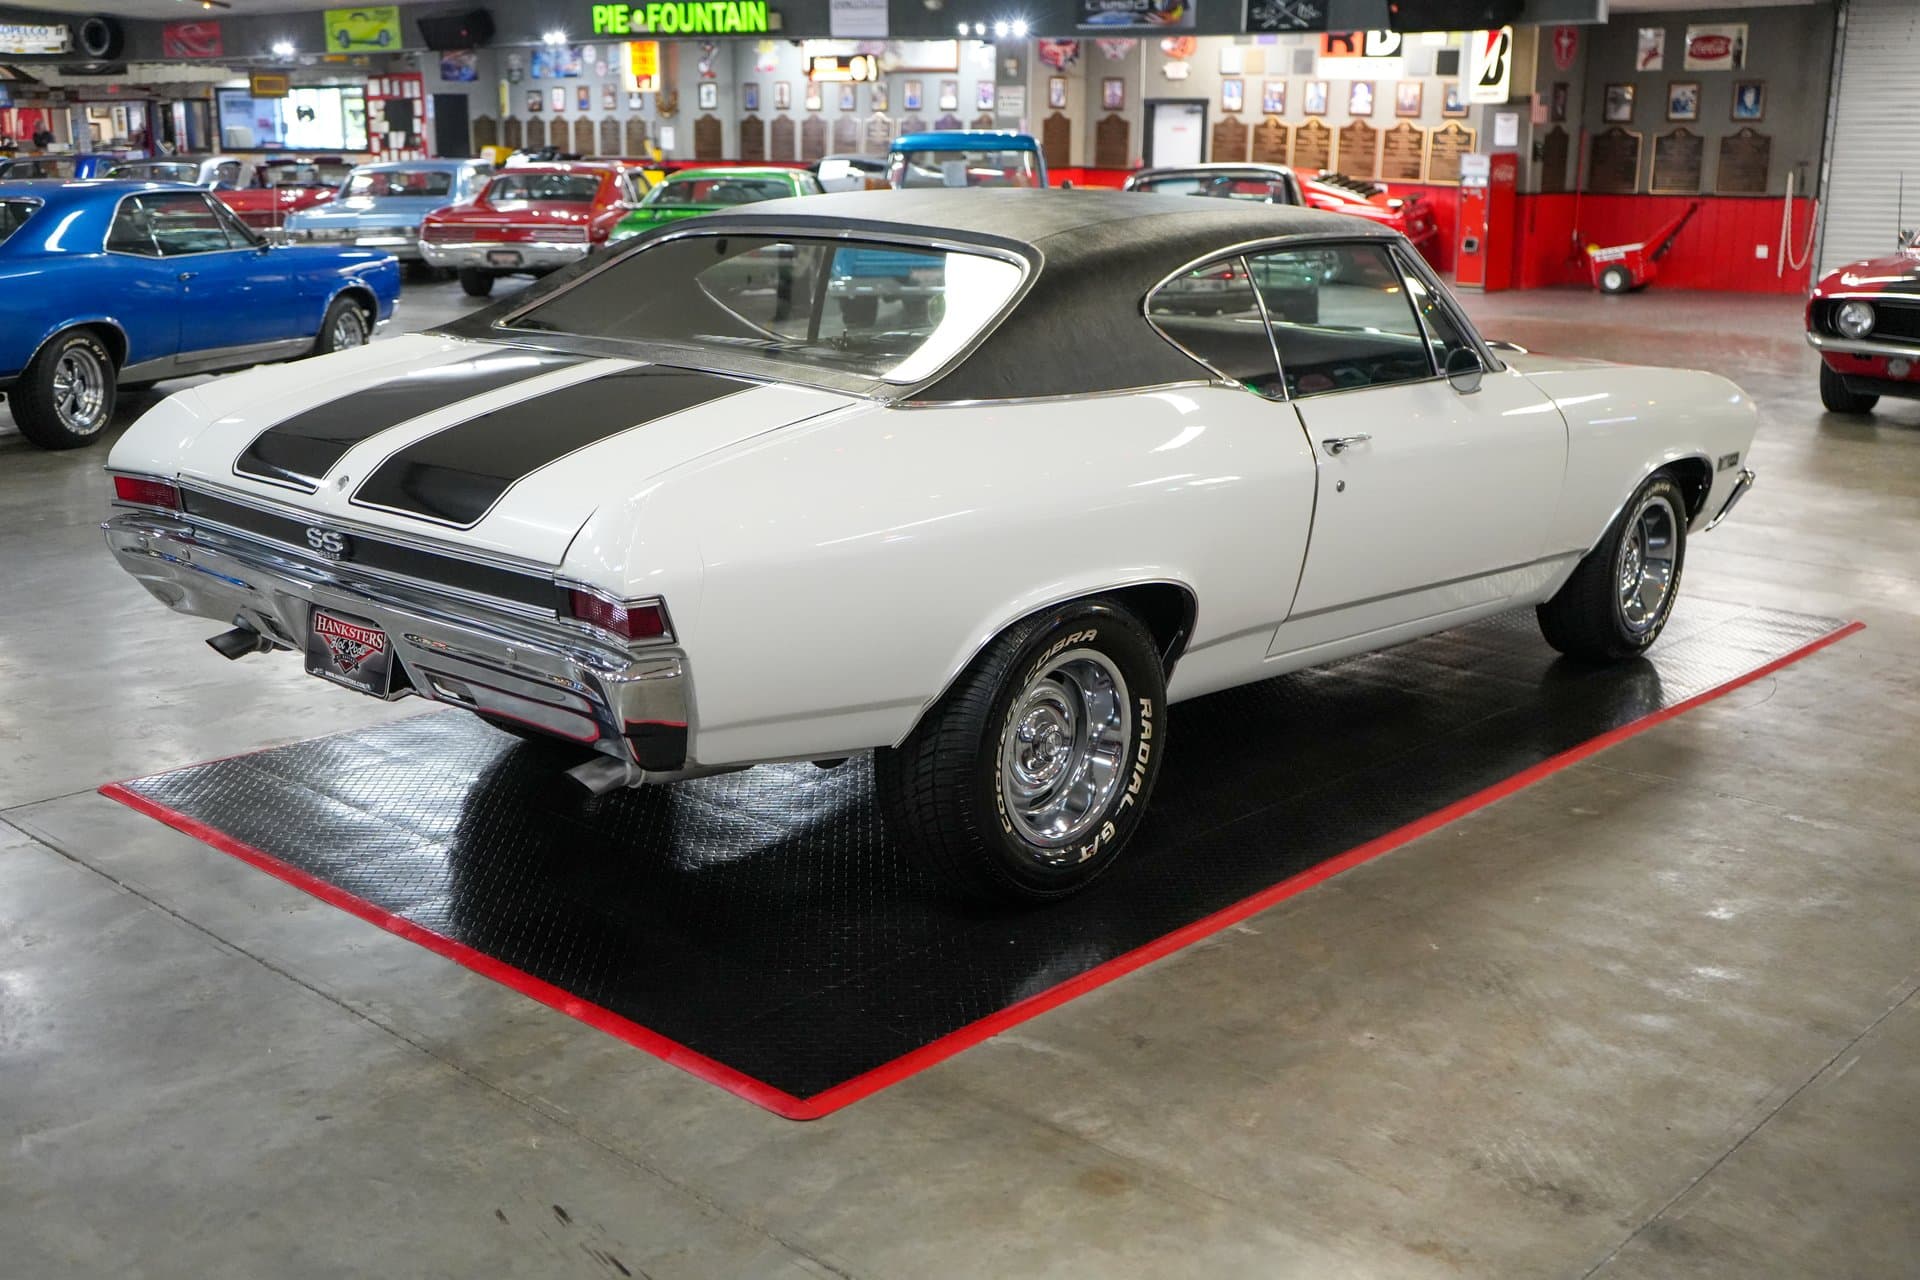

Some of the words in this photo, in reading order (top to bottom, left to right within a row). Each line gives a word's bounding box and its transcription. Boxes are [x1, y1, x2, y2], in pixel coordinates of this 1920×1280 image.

[592, 4, 631, 34] PIE
[646, 1, 768, 34] FOUNTAIN
[306, 527, 344, 553] SS
[317, 615, 384, 649] HANKSTERS
[1024, 629, 1098, 687] COBRA
[1120, 697, 1153, 810] RADIAL
[1078, 820, 1116, 863] G/T
